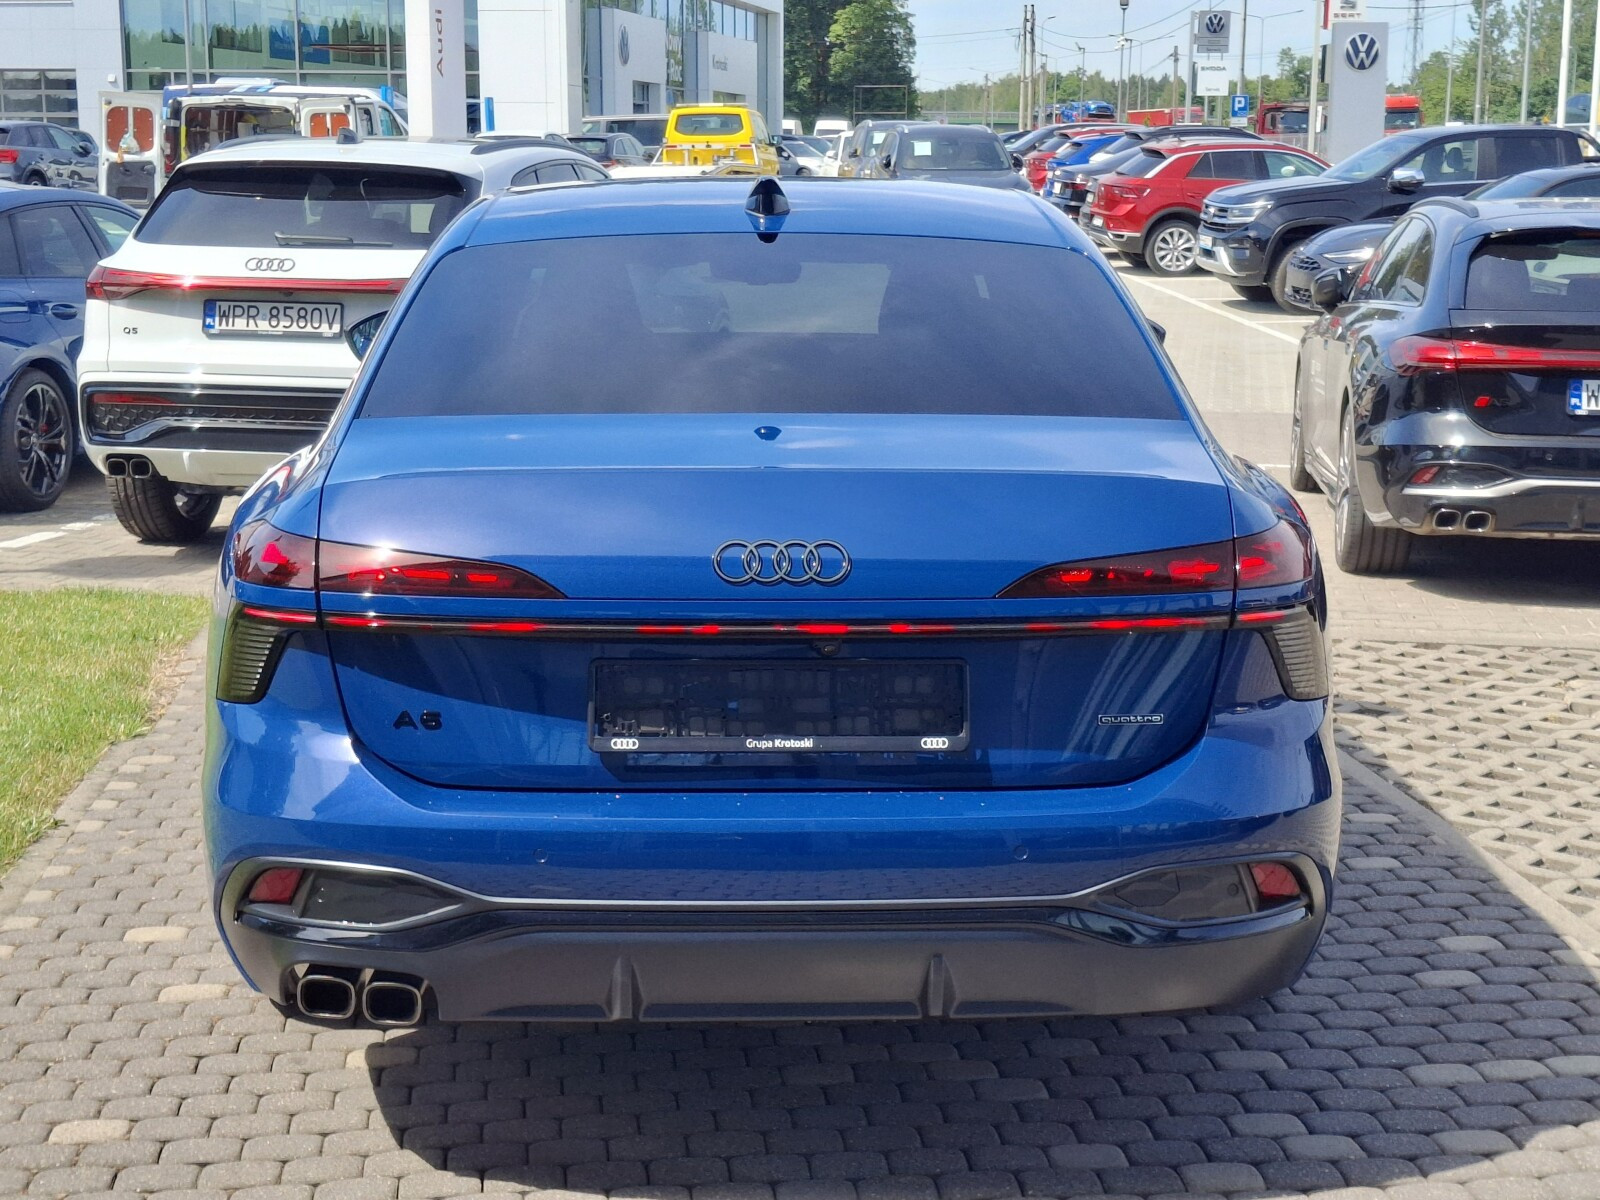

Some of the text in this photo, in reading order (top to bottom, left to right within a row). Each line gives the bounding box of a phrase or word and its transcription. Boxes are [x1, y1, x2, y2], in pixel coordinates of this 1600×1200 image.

[435, 9, 443, 78] Audi
[1235, 97, 1245, 111] P
[218, 304, 338, 331] WPR 8580V
[123, 326, 138, 335] Q5
[393, 710, 442, 730] A6
[1101, 715, 1161, 724] quattro
[746, 738, 813, 749] Grupa Krotoski
